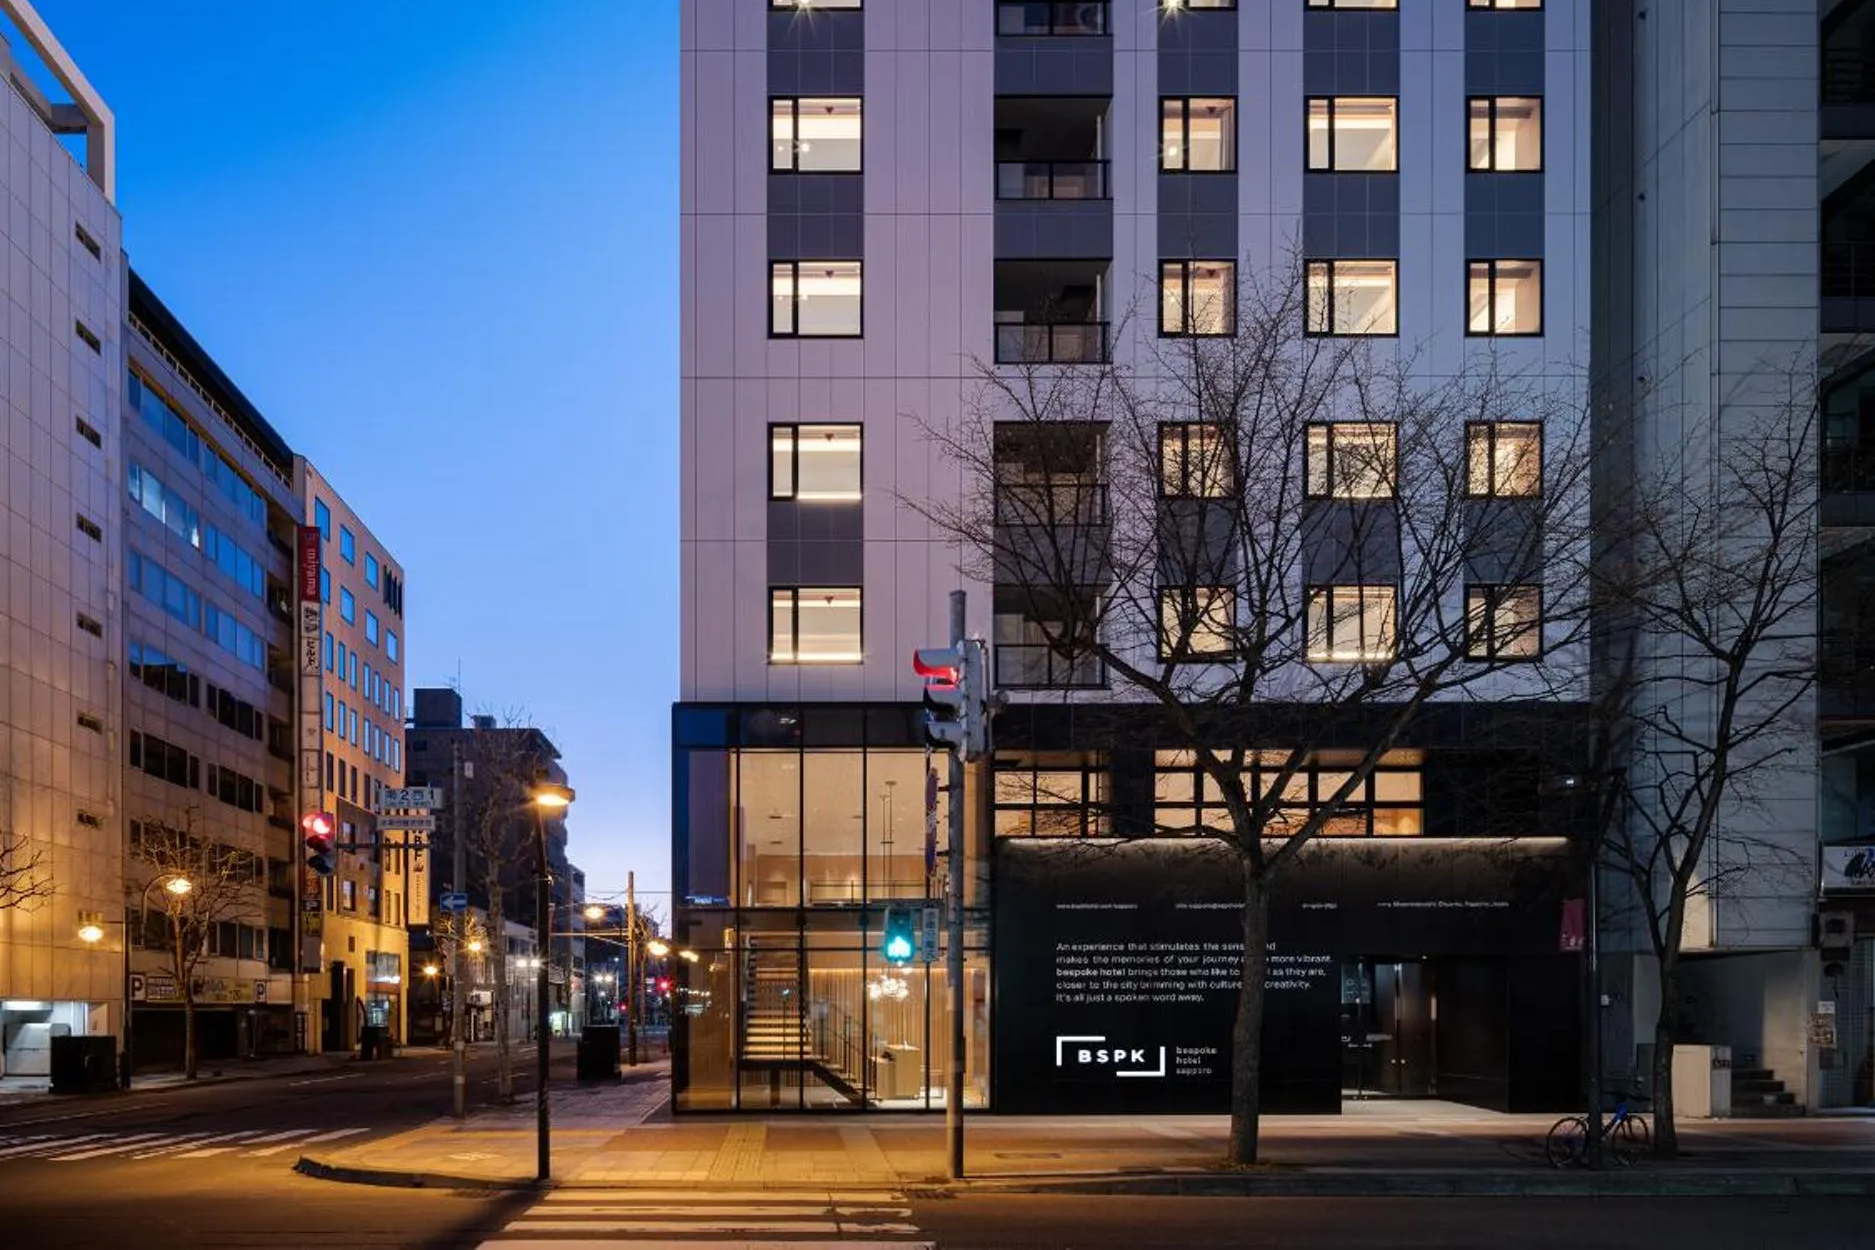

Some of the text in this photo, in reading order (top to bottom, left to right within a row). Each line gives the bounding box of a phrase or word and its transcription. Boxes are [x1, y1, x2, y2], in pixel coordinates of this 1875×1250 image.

[1056, 942, 1070, 951] An
[1072, 942, 1125, 953] experience
[1128, 942, 1147, 951] that
[1149, 942, 1200, 951] stimulates
[1203, 942, 1219, 951] the
[1056, 955, 1089, 964] makes
[1093, 955, 1109, 964] the
[1112, 955, 1161, 964] memories
[1163, 955, 1174, 964] of
[1178, 956, 1200, 966] your
[1202, 955, 1239, 966] journey
[1056, 968, 1099, 978] bespoke
[1100, 968, 1126, 976] hotel
[1128, 968, 1159, 978] brings
[1160, 968, 1187, 976] those
[1229, 968, 1241, 976] to
[1286, 968, 1305, 978] they
[1056, 981, 1086, 989] closer
[1089, 981, 1100, 989] to
[1102, 981, 1119, 989] the
[1121, 981, 1137, 991] city
[1140, 981, 1186, 991] brimming
[1187, 981, 1208, 989] with
[1210, 981, 1243, 989] culture
[1086, 994, 1105, 1004] just
[1152, 994, 1176, 1002] word
[1077, 1048, 1146, 1064] BSPK
[1175, 1046, 1218, 1056] bespoke
[1175, 1056, 1201, 1064] hotel
